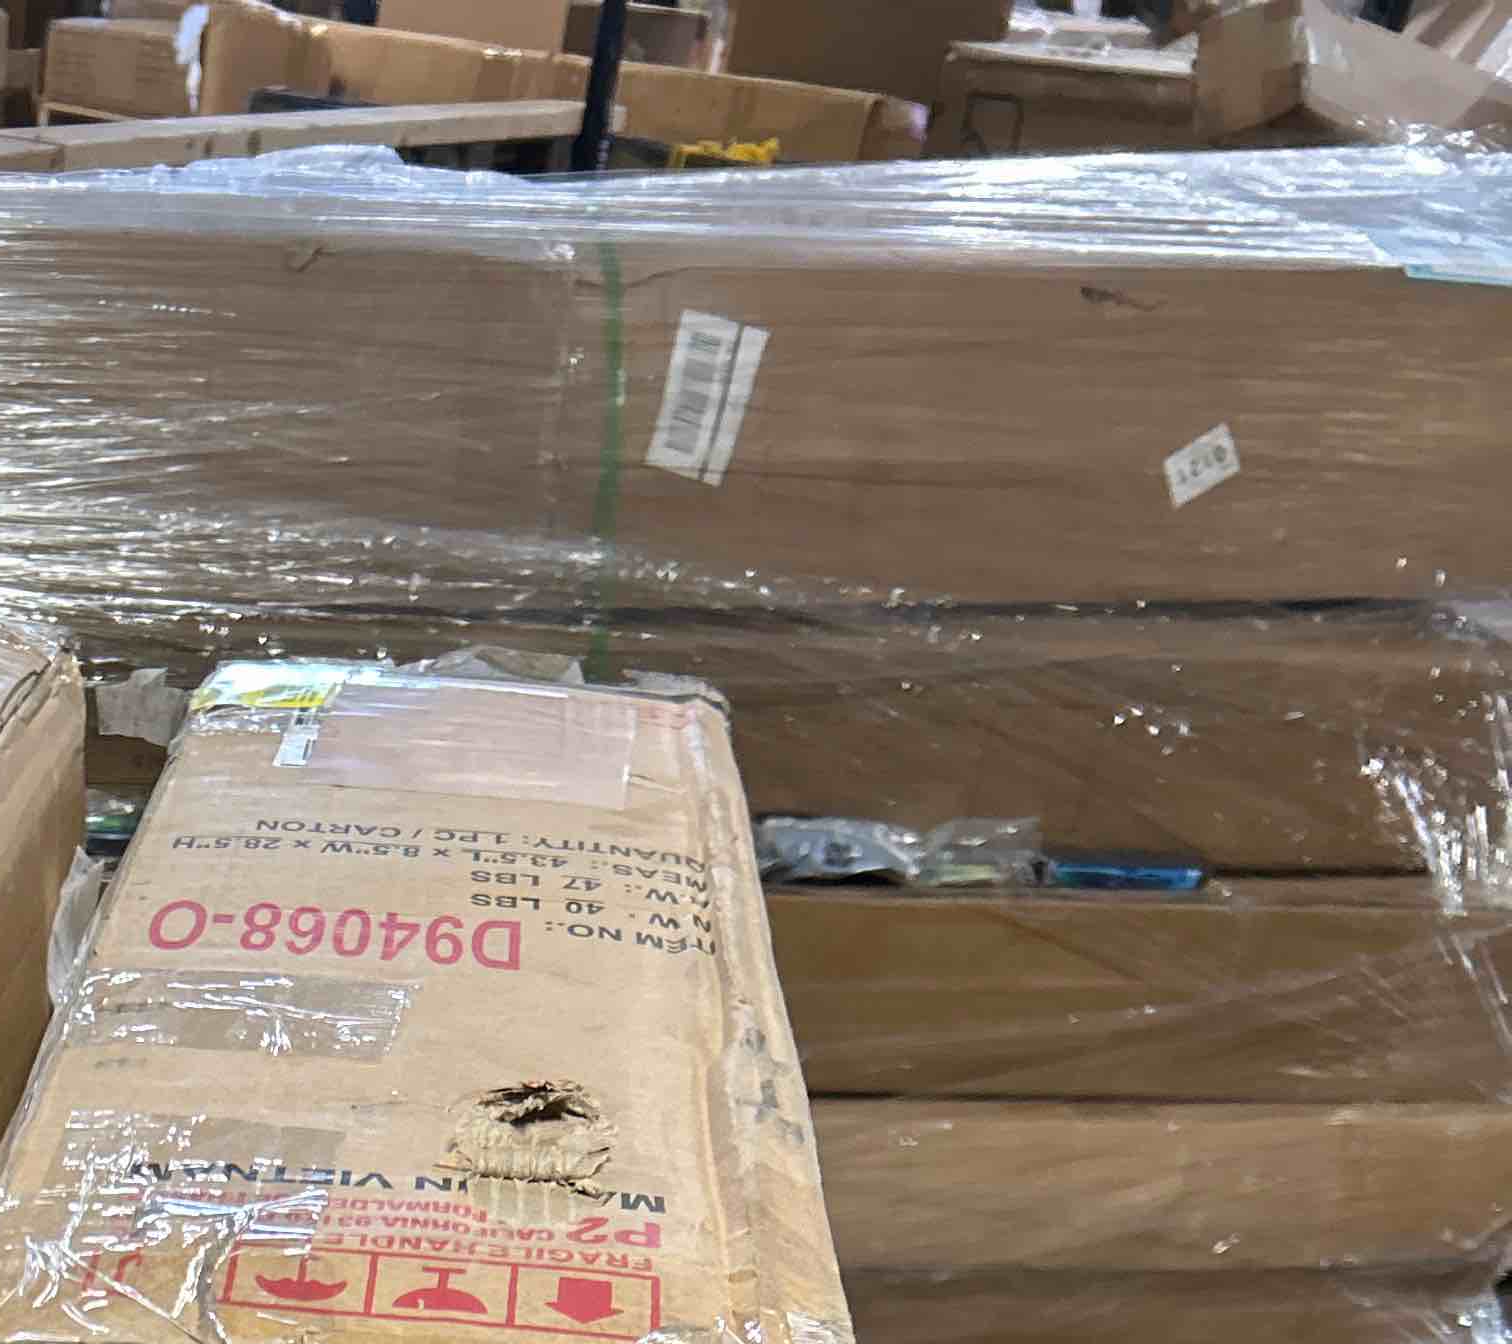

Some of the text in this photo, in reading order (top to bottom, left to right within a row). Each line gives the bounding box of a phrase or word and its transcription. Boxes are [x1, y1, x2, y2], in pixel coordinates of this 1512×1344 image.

[255, 818, 402, 840] CARTON
[433, 828, 479, 843] PC
[172, 835, 281, 852] 28.5"H
[293, 838, 314, 850] x
[320, 840, 420, 858] 8.5"W
[433, 847, 451, 858] x
[471, 847, 569, 870] 43.5"L
[471, 869, 540, 889] LBS
[560, 873, 602, 893] 47
[471, 892, 541, 911] LBS
[565, 897, 605, 915] 40
[148, 897, 523, 972] D94068-O
[545, 920, 622, 942] NO.:
[567, 1217, 662, 1249] P2
[330, 1232, 654, 1271] FRAGILE HANDLE
